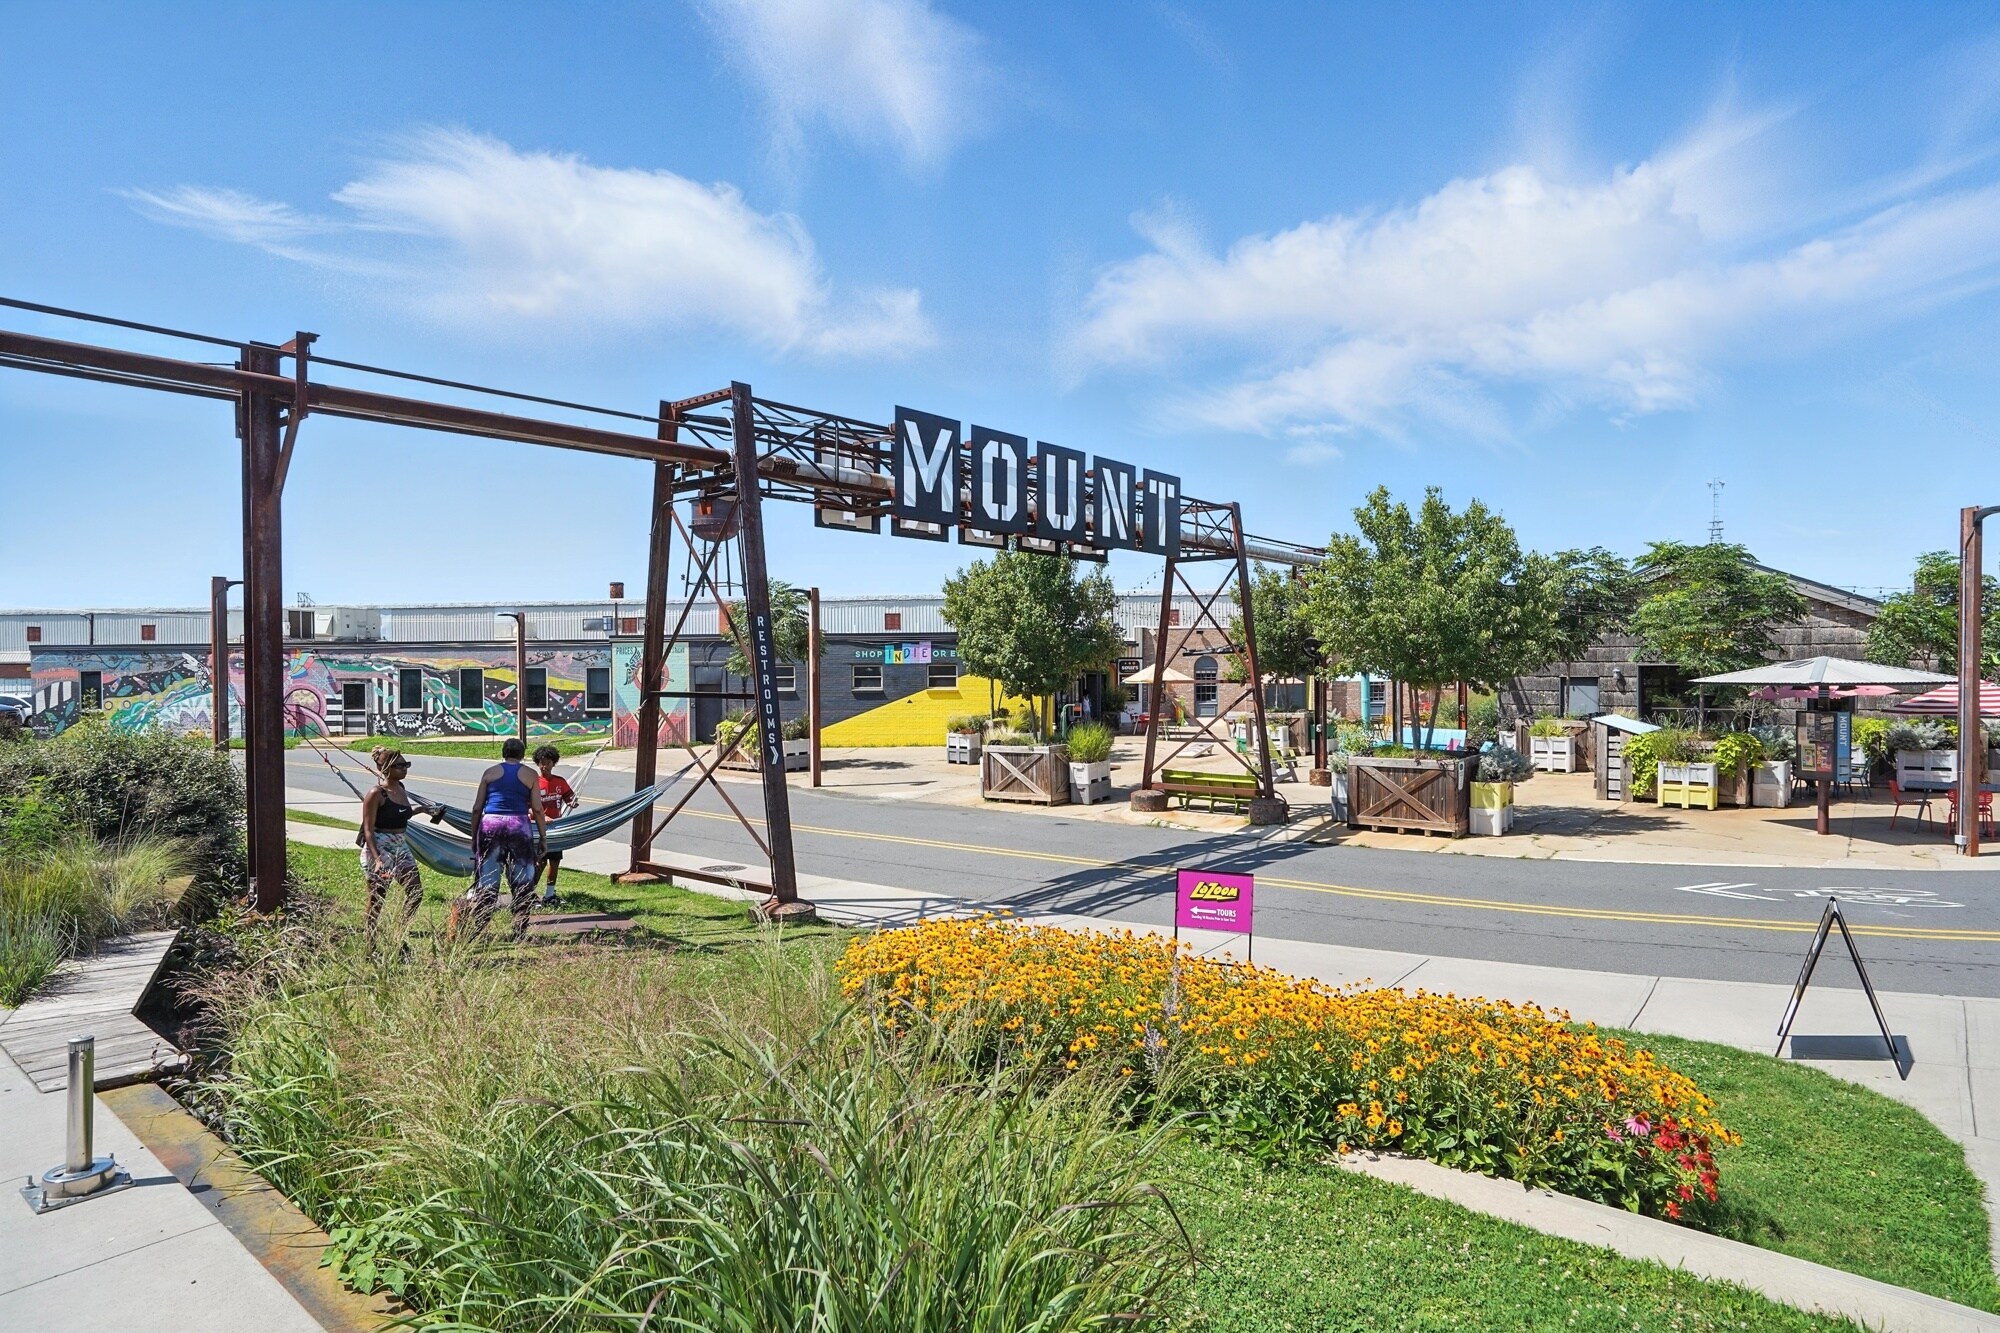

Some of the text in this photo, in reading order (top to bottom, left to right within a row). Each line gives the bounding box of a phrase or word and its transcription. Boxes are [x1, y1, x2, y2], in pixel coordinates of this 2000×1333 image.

[903, 419, 1175, 547] MOUNT
[615, 646, 634, 655] PRICES
[855, 650, 883, 658] SHOP
[885, 647, 928, 662] INDIE
[757, 616, 776, 744] RESTROOMS
[1216, 908, 1237, 918] TOURS
